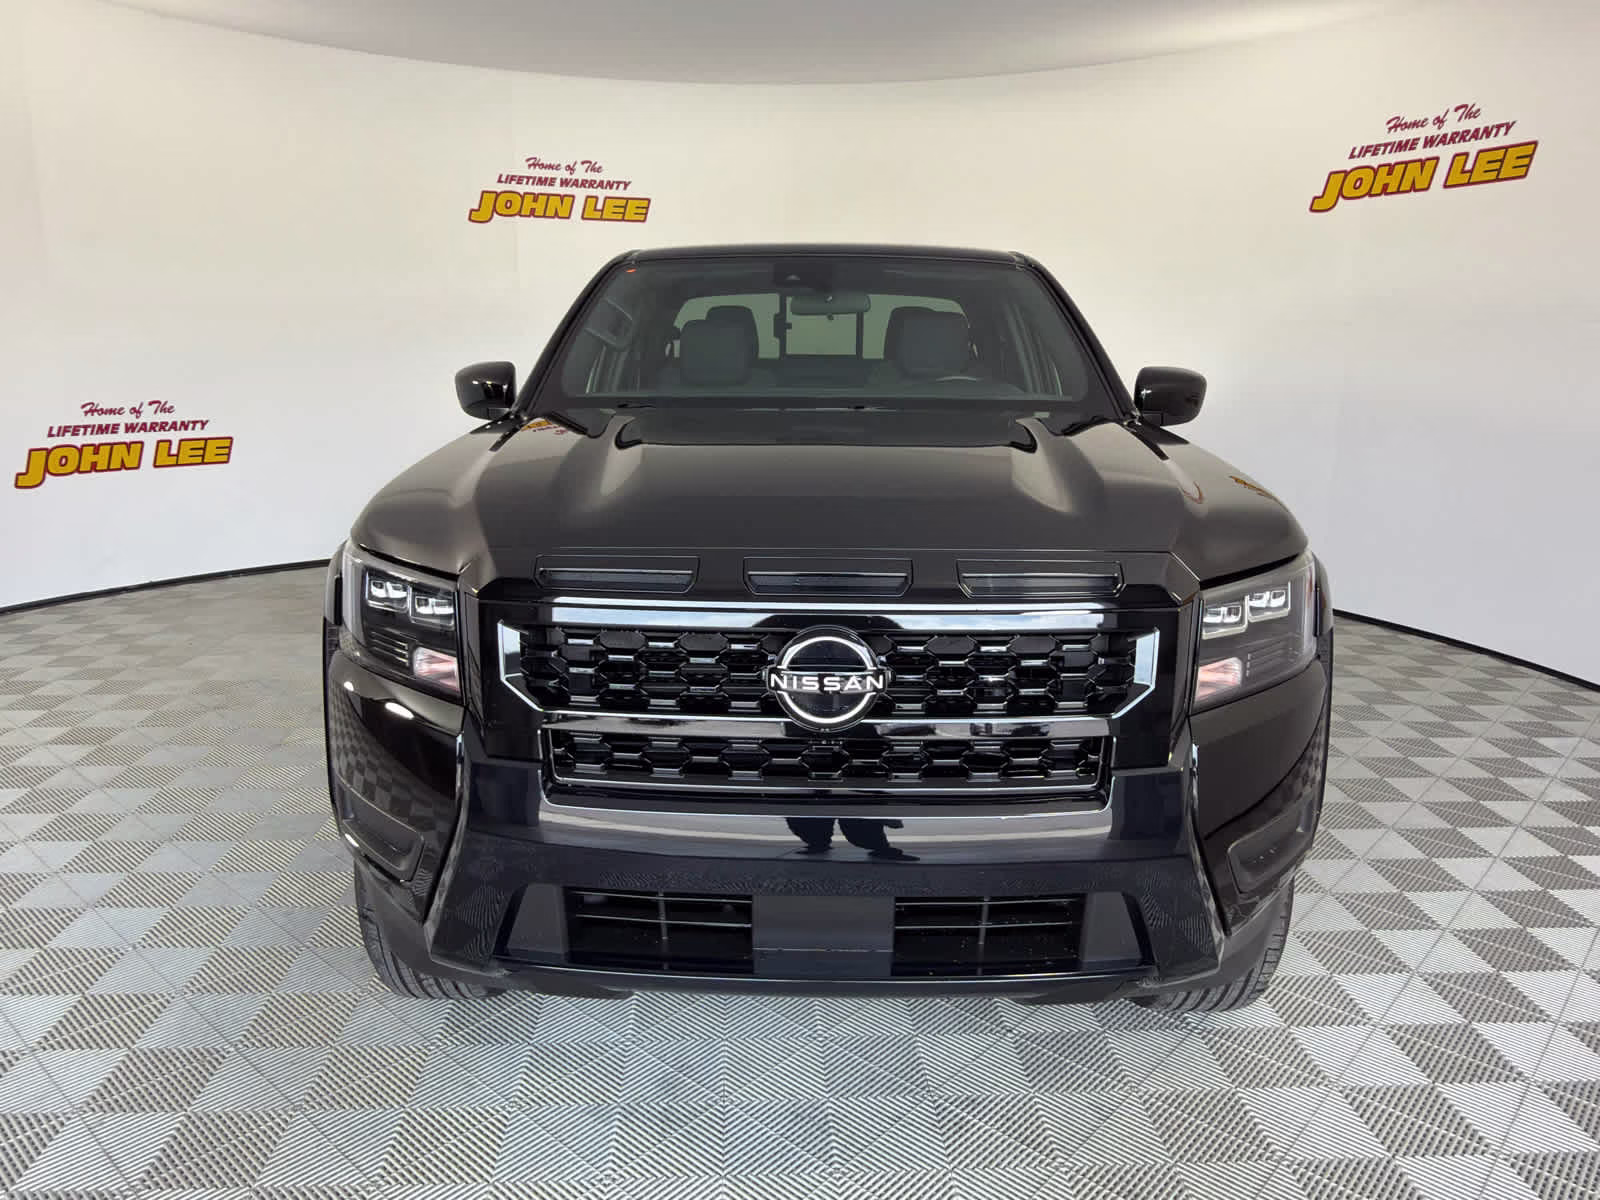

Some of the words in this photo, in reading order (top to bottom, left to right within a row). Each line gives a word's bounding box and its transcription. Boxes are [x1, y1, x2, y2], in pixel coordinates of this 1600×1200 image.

[1386, 116, 1429, 134] Home
[1432, 109, 1449, 130] of
[1454, 103, 1481, 122] The
[1348, 137, 1420, 159] LIFETIME
[1422, 120, 1517, 149] WARRANTY
[525, 157, 561, 171] Home
[565, 161, 577, 175] of
[581, 160, 603, 173] The
[1309, 156, 1440, 212] JOHN
[1443, 140, 1538, 189] LEE
[497, 174, 556, 187] LIFETIME
[560, 178, 632, 191] WARRANTY
[468, 191, 575, 223] JOHN
[581, 195, 651, 223] LEE
[80, 402, 125, 417] Home
[129, 402, 144, 419] of
[148, 400, 175, 415] The
[47, 423, 119, 438] LIFETIME
[124, 420, 209, 434] WARRANTY
[15, 441, 144, 489] JOHN
[153, 436, 233, 468] LEE
[770, 673, 883, 691] NISSAN
